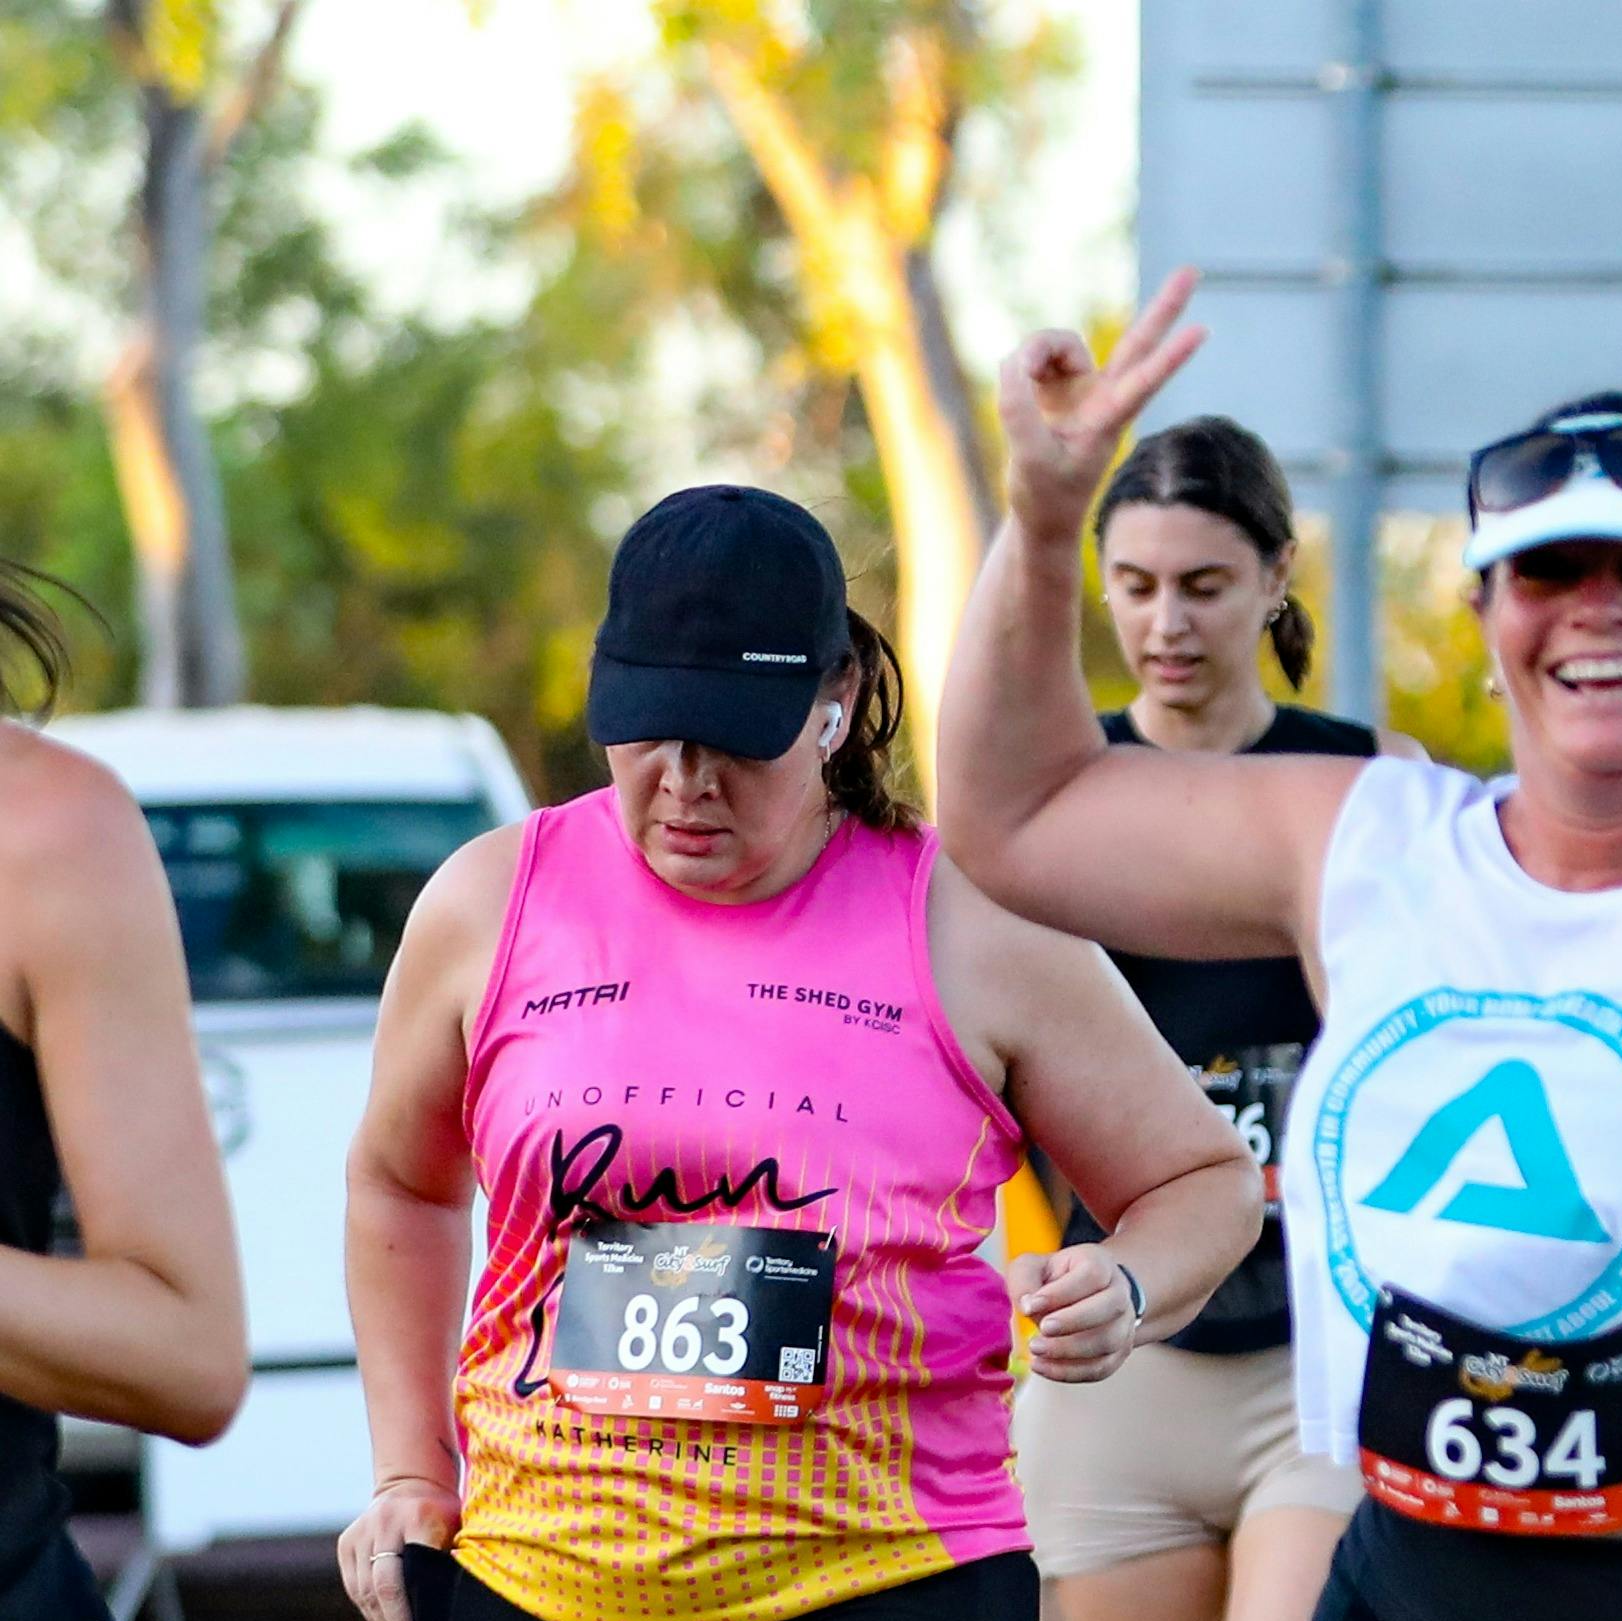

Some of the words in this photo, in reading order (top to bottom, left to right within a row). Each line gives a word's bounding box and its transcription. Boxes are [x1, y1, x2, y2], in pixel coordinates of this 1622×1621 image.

[748, 983, 788, 1000] THE
[794, 987, 851, 1010] SHED
[857, 998, 902, 1022] GYM
[843, 1015, 860, 1026] BY
[525, 1086, 848, 1123] UNOFFICIAL
[547, 1123, 839, 1243] Run
[617, 1294, 748, 1375] 863
[704, 1382, 745, 1396] Santos
[536, 1419, 737, 1466] KATHERINE
[1425, 1399, 1607, 1489] 634
